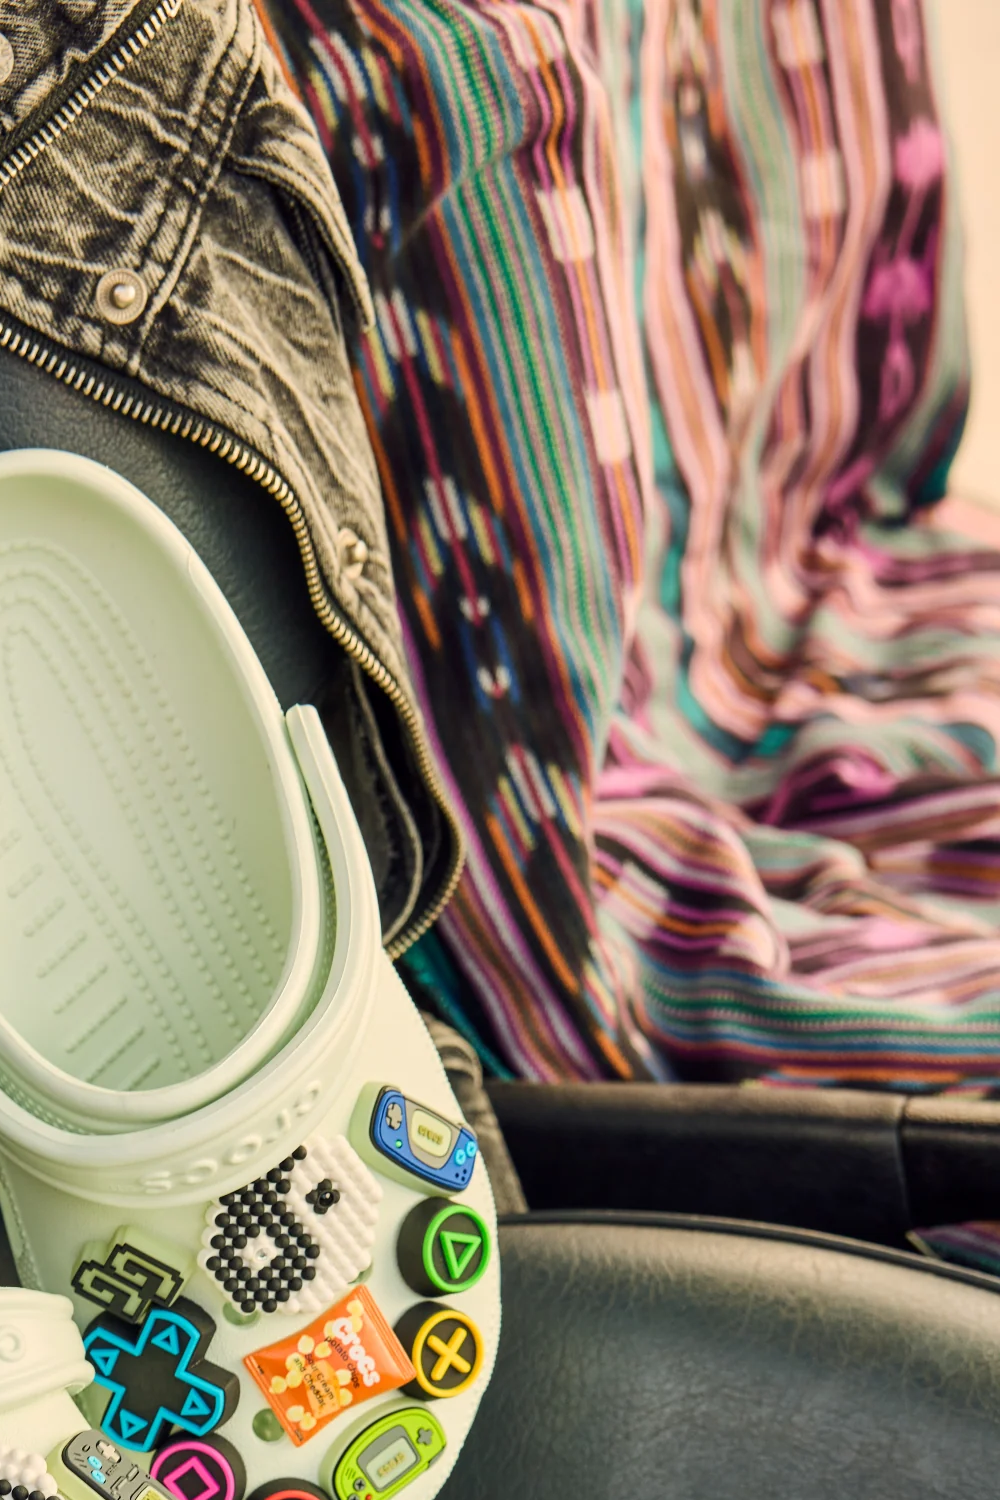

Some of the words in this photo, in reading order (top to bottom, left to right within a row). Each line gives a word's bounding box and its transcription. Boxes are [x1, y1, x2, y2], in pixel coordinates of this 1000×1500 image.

[294, 1358, 306, 1372] and
[304, 1373, 326, 1406] Cheddar
[305, 1354, 319, 1372] Sour
[317, 1373, 334, 1400] Cream
[324, 1336, 348, 1361] potato
[347, 1363, 360, 1389] chips
